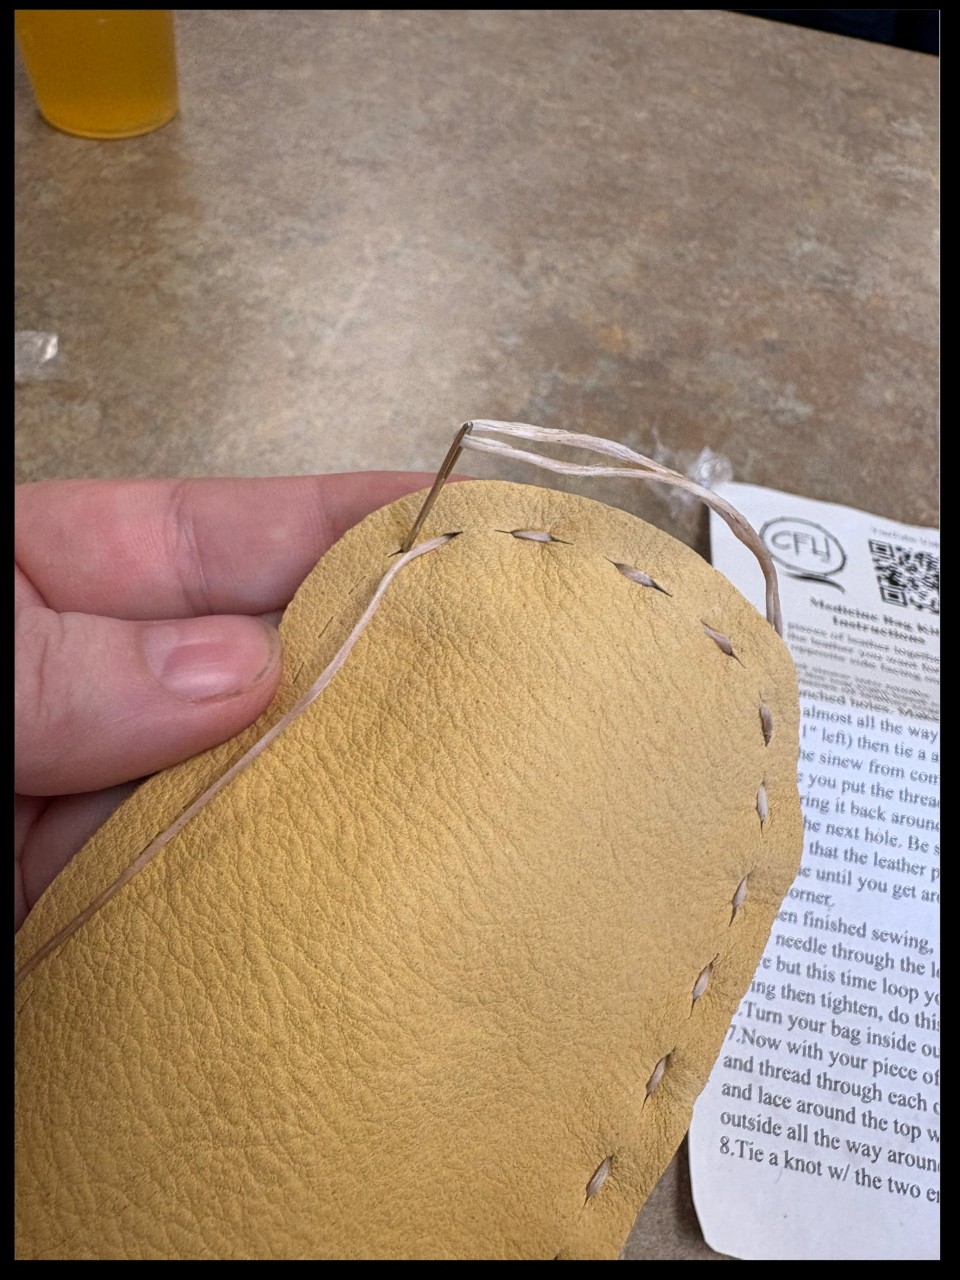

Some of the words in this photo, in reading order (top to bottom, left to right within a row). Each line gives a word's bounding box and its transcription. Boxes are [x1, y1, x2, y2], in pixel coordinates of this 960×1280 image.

[800, 690, 846, 706] nched
[803, 705, 852, 726] almost
[856, 714, 875, 730] all
[880, 718, 903, 735] the
[907, 724, 938, 745] way
[822, 726, 853, 750] left)
[858, 734, 889, 754] then
[895, 740, 913, 759] tie
[918, 749, 927, 761] a
[819, 749, 863, 770] sinew
[869, 753, 905, 776] from
[808, 772, 837, 789] you
[841, 779, 866, 796] put
[871, 781, 894, 800] the
[899, 786, 939, 808] threa
[835, 796, 846, 815] it
[851, 799, 887, 822] back
[803, 813, 822, 832] he
[826, 821, 860, 841] next
[908, 833, 930, 853] Be
[809, 839, 839, 860] that
[843, 846, 869, 866] the
[873, 850, 928, 877] leather
[816, 868, 852, 887] until
[857, 875, 888, 893] you
[892, 883, 917, 900] get
[803, 910, 867, 939] finished
[871, 929, 934, 956] sewing,
[775, 933, 828, 956] needle
[832, 941, 896, 972] through
[900, 955, 926, 976] the
[776, 953, 801, 976] but
[806, 963, 836, 984] this
[840, 970, 878, 992] time
[882, 976, 919, 1004] loop
[780, 982, 816, 1006] then
[820, 991, 884, 1024] tighten,
[888, 1005, 910, 1025] do
[787, 1013, 827, 1033] your
[831, 1018, 861, 1047] bag
[866, 1026, 917, 1054] inside
[786, 1039, 823, 1062] with
[828, 1049, 868, 1069] your
[872, 1056, 918, 1079] piece
[922, 1068, 939, 1087] of
[723, 1055, 754, 1074] and
[758, 1059, 812, 1086] thread
[816, 1071, 883, 1104] through
[888, 1090, 927, 1114] each
[721, 1083, 753, 1101] and
[758, 1085, 792, 1110] lace
[796, 1098, 856, 1126] around
[861, 1110, 888, 1132] the
[893, 1118, 922, 1144] top
[720, 1111, 782, 1138] outside
[786, 1122, 808, 1144] all
[813, 1128, 841, 1151] the
[845, 1139, 882, 1164] way
[887, 1148, 939, 1174] aroun
[719, 1134, 764, 1163] 8.Tie
[768, 1151, 778, 1167] a
[783, 1149, 822, 1178] knot
[827, 1163, 850, 1183] w/
[855, 1166, 882, 1191] the
[888, 1176, 921, 1199] two
